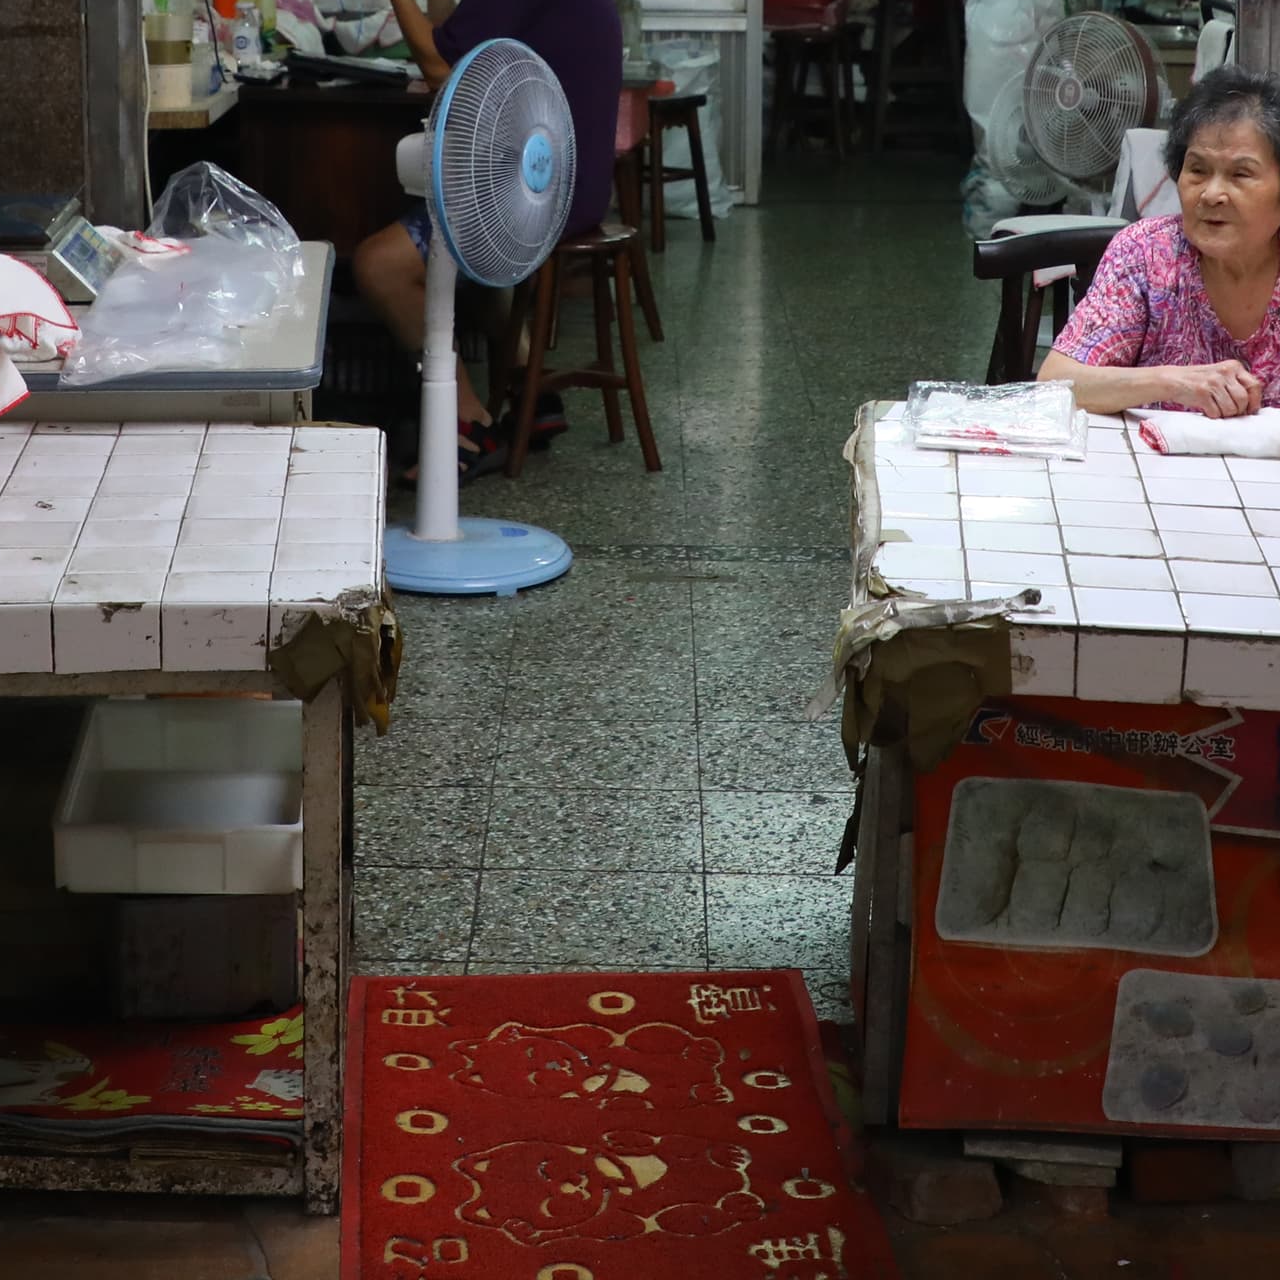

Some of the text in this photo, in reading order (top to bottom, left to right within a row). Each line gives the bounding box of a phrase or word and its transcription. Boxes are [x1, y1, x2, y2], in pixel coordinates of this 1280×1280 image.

[1015, 724, 1236, 760] 經濟部中部辦公室
